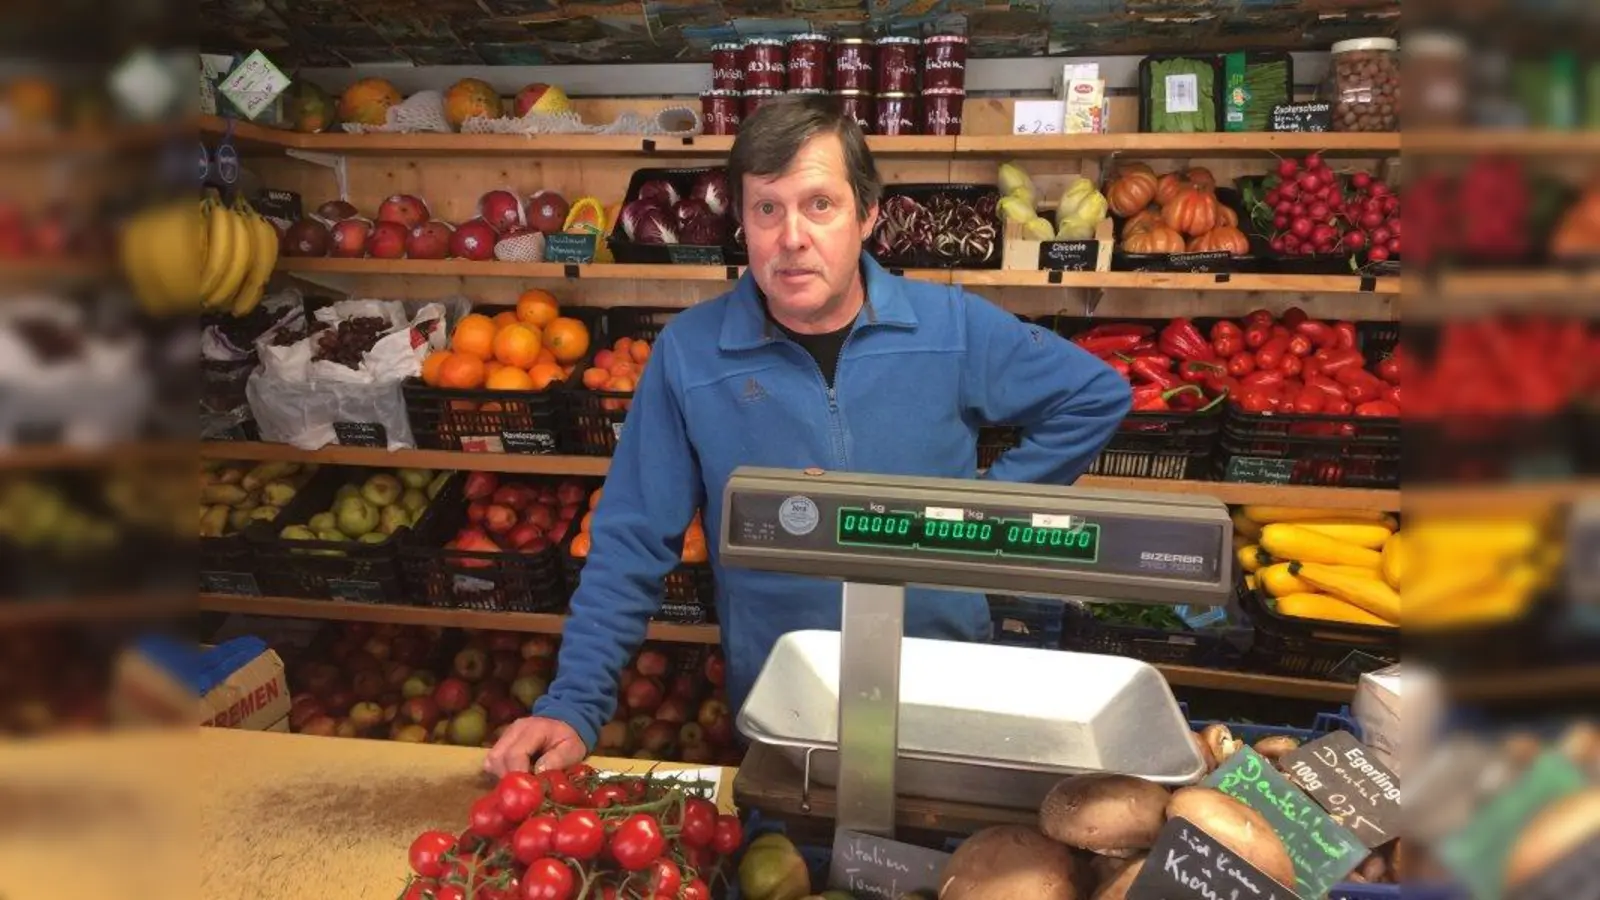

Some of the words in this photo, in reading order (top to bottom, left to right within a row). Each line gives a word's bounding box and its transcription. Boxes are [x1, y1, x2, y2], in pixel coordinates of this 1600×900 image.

[870, 503, 885, 514] kg
[1140, 551, 1204, 565] BIZERBA
[1292, 761, 1323, 791] 100g
